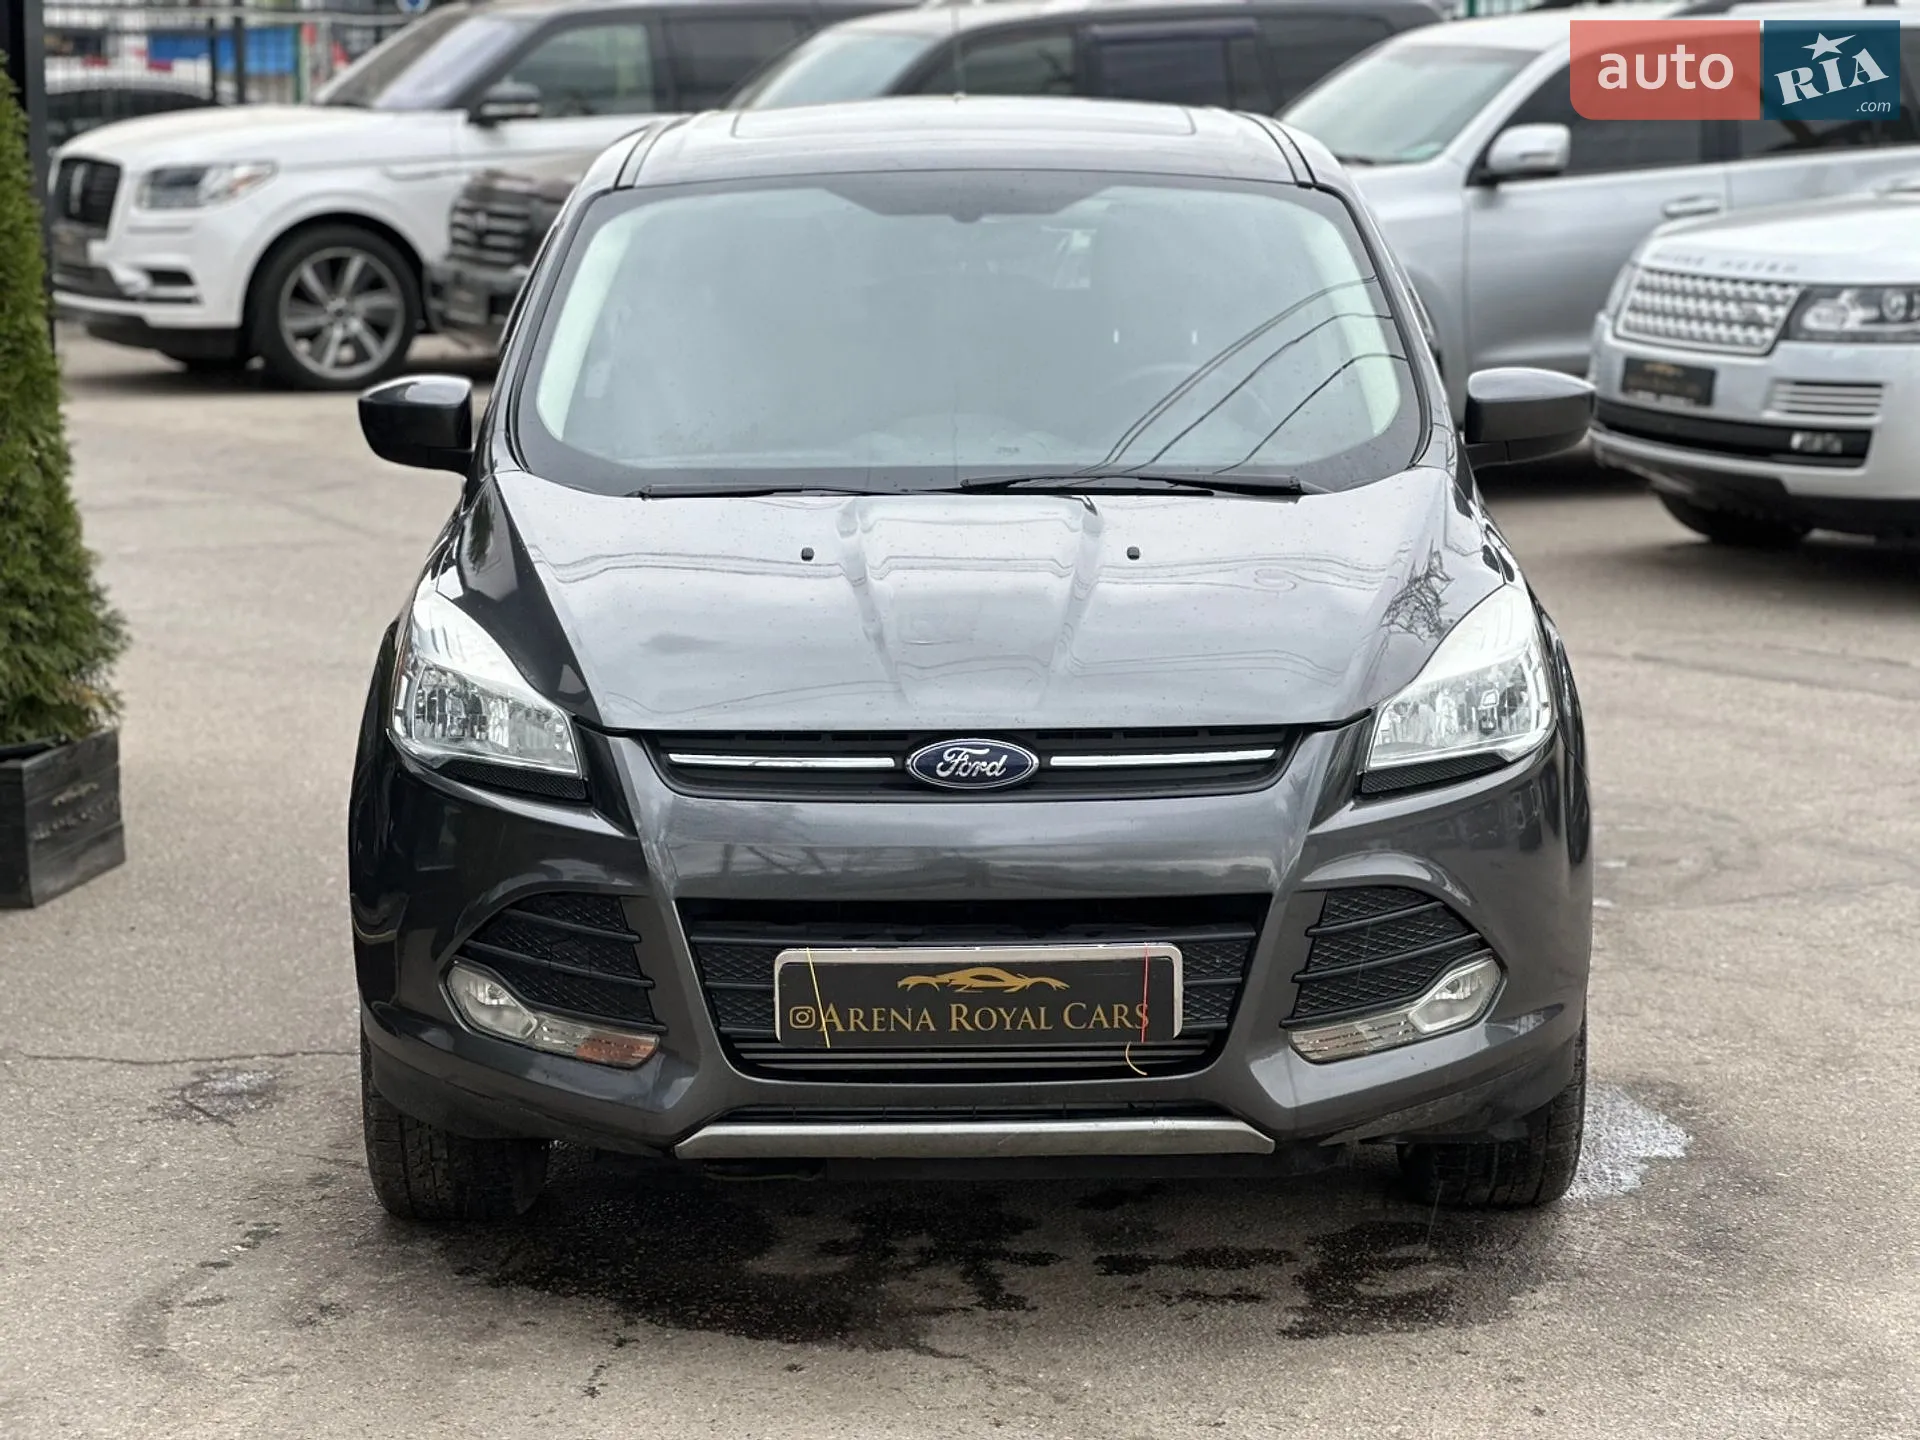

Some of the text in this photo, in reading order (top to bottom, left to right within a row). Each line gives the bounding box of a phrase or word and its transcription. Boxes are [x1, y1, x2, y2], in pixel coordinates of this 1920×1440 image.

[936, 747, 1008, 777] Ford
[820, 1002, 1149, 1032] ARENA ROYAL CARS
